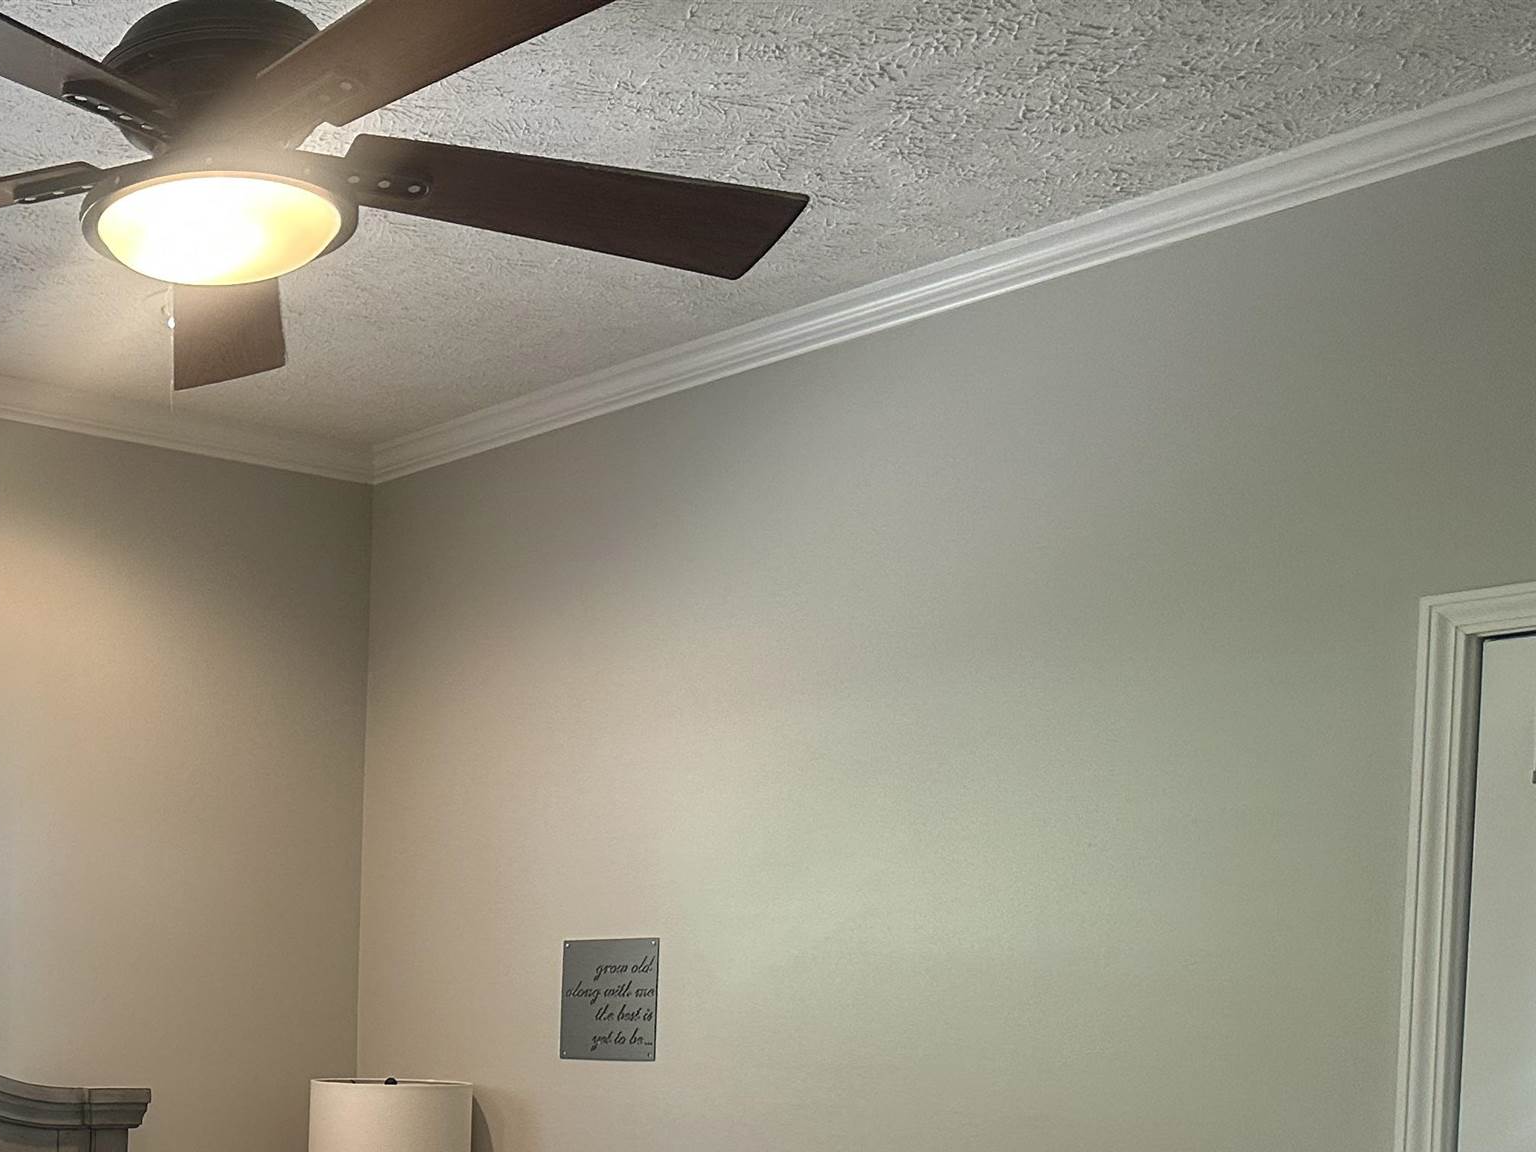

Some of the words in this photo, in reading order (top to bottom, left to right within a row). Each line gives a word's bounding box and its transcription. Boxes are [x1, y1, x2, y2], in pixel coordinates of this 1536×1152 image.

[593, 963, 628, 982] grow
[631, 955, 655, 973] old
[565, 981, 601, 1005] along
[603, 980, 633, 998] with
[634, 986, 655, 998] me
[594, 1004, 616, 1022] the
[616, 1004, 642, 1022] best
[642, 1008, 653, 1022] is
[590, 1030, 613, 1053] yet
[613, 1030, 628, 1045] to
